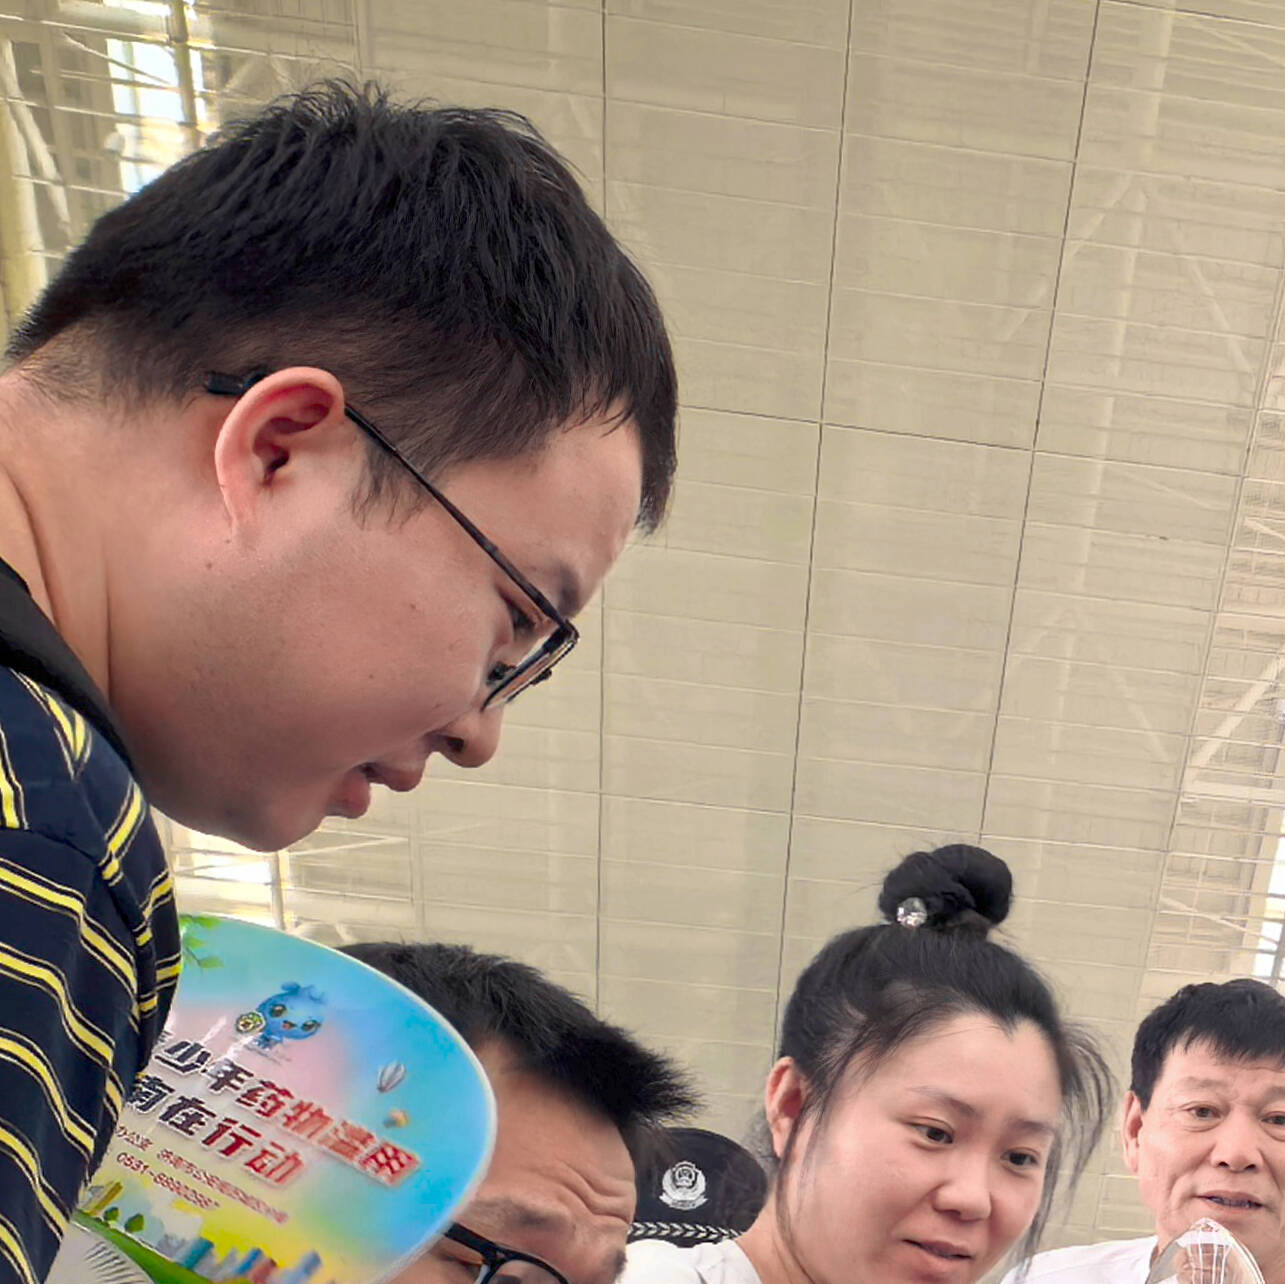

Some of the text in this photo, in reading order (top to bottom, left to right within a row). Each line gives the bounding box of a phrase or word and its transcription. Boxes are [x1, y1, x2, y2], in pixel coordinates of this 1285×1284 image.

[154, 1030, 422, 1187] 少年药物滥用
